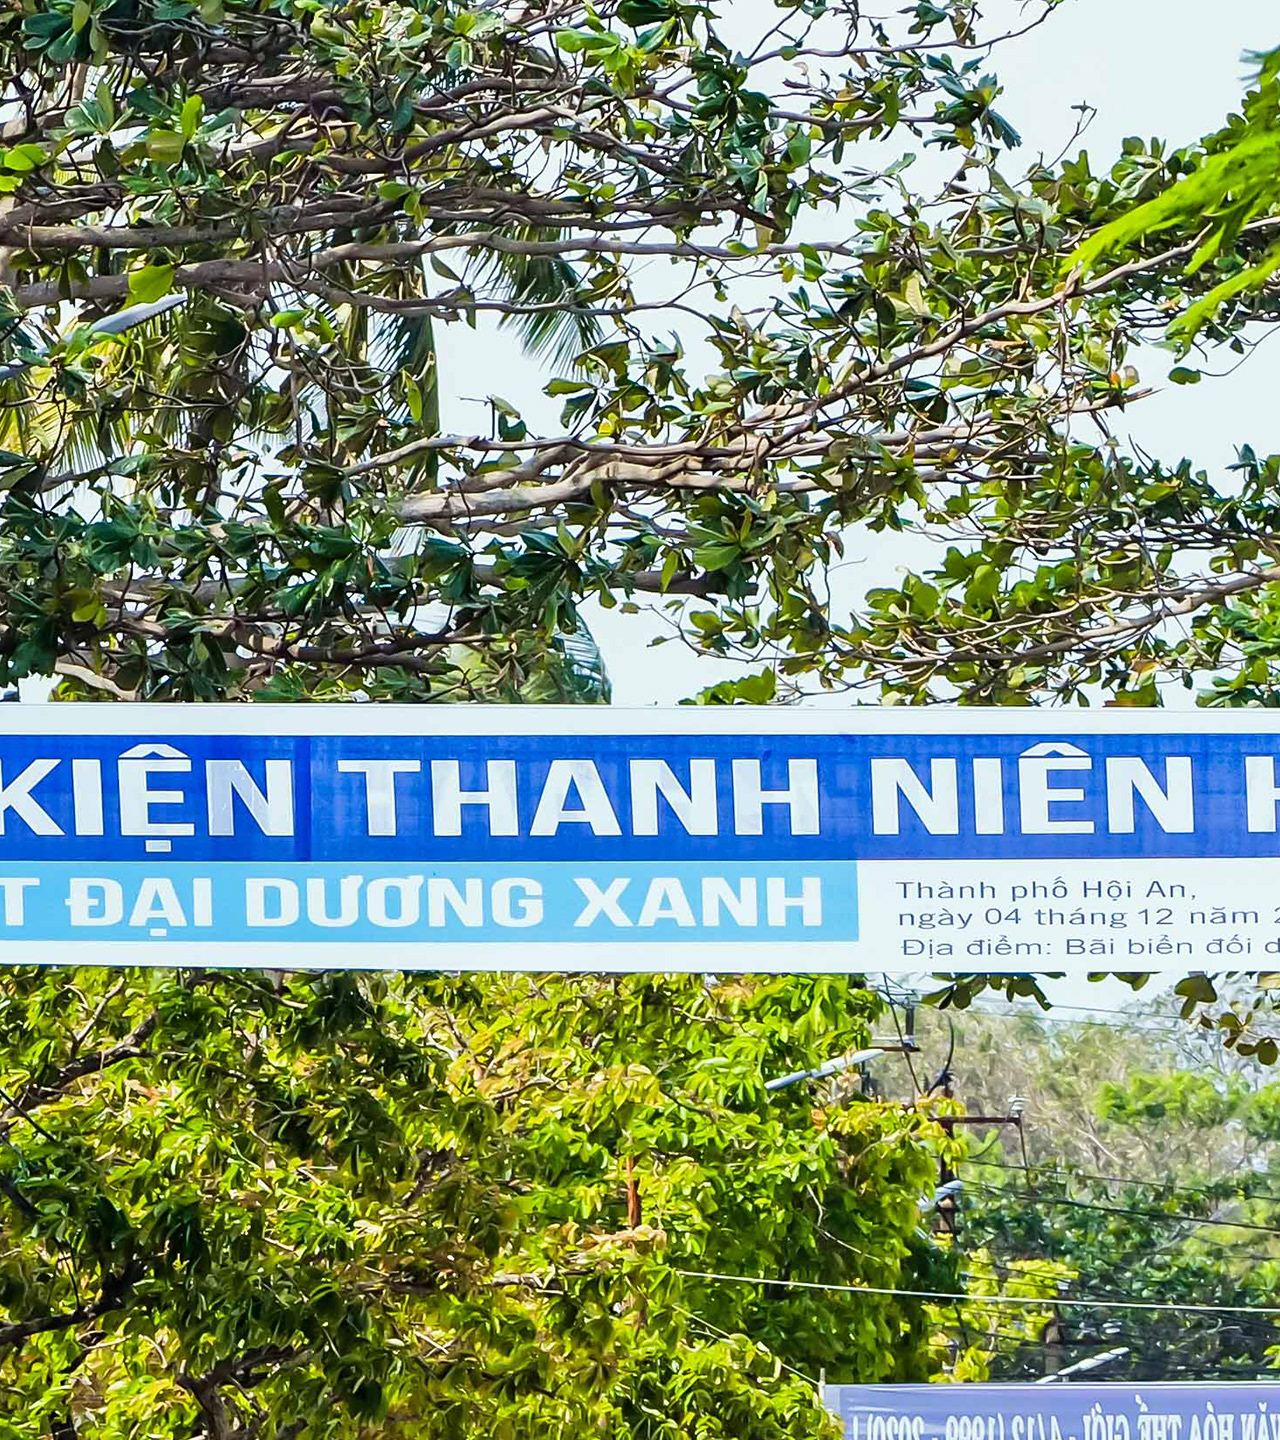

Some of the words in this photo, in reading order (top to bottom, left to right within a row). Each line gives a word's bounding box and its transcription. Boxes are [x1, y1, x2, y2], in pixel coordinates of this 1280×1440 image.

[337, 757, 821, 838] THANH
[870, 741, 1195, 836] NIÊN
[65, 876, 213, 937] ĐẠI
[247, 873, 544, 929] DƯƠNG
[573, 876, 823, 928] XANH
[896, 880, 995, 900] Thành
[1011, 875, 1068, 907] phố
[1082, 879, 1134, 899] Hội
[1146, 881, 1197, 901] An,
[897, 905, 973, 930] ngày
[985, 907, 1022, 926] 04
[1033, 904, 1130, 930] tháng
[1138, 906, 1172, 925] 12
[1190, 903, 1260, 925] năm
[900, 937, 970, 959] Địa
[976, 932, 1052, 956] điểm:
[1065, 934, 1117, 956] Bãi
[1127, 932, 1193, 956] biển
[1205, 933, 1253, 956] đối
